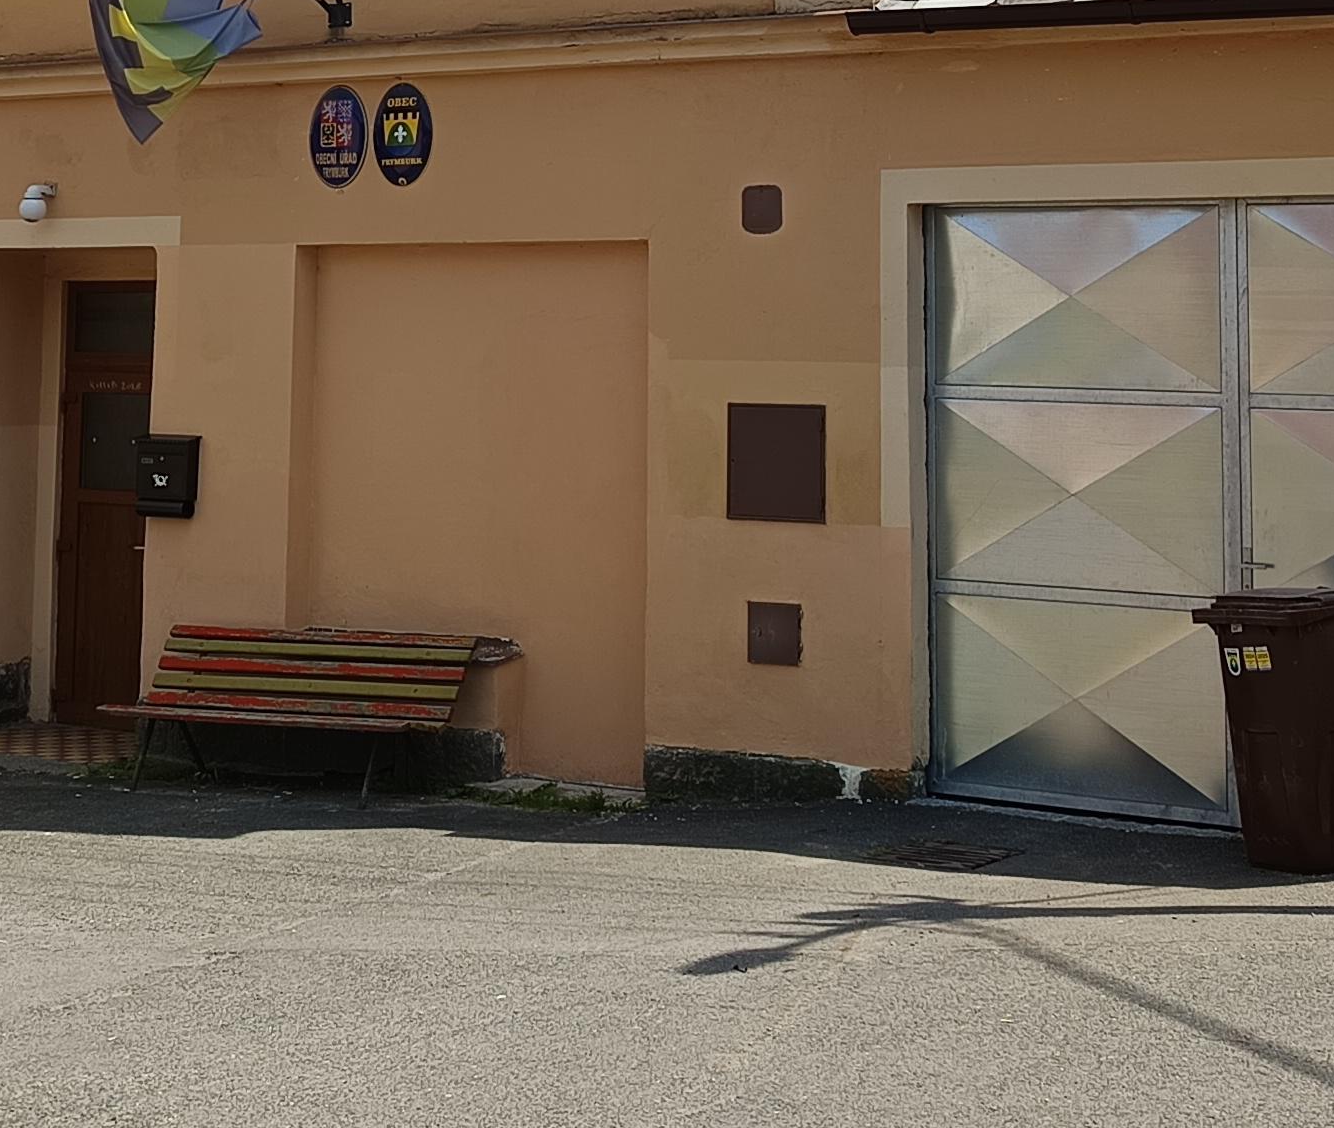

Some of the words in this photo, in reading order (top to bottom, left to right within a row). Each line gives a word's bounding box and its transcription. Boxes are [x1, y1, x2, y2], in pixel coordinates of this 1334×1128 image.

[387, 97, 417, 108] OBEC
[315, 150, 337, 165] OBECNÍ
[339, 149, 358, 164] ÚŘAD
